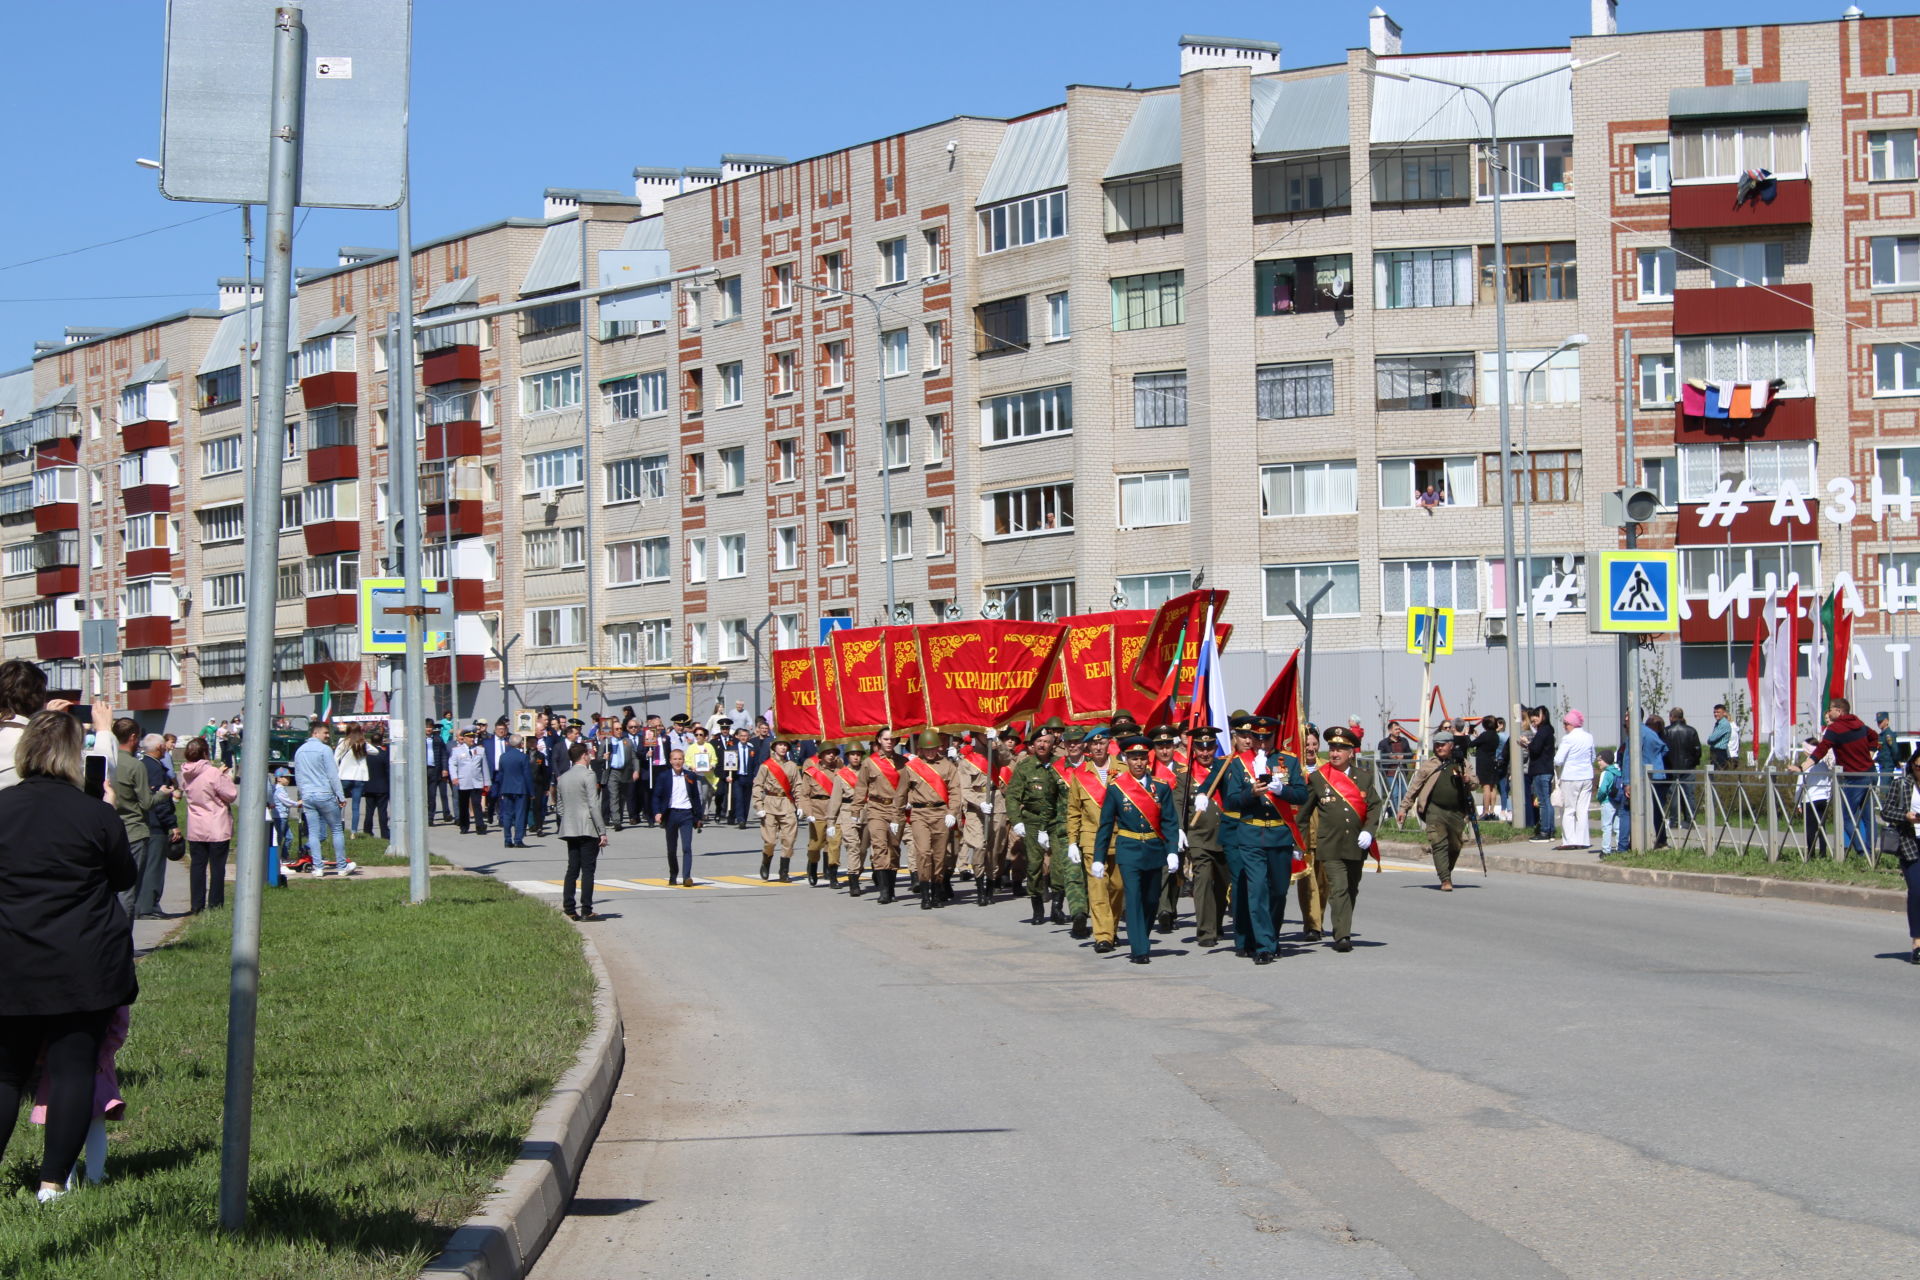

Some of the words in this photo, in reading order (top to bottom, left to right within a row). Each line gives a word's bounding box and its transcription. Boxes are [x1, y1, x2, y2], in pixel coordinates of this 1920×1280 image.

[988, 647, 998, 664] 2
[943, 667, 1040, 691] УКРАИНСКИЙ
[977, 695, 1009, 714] ФРОНТ
